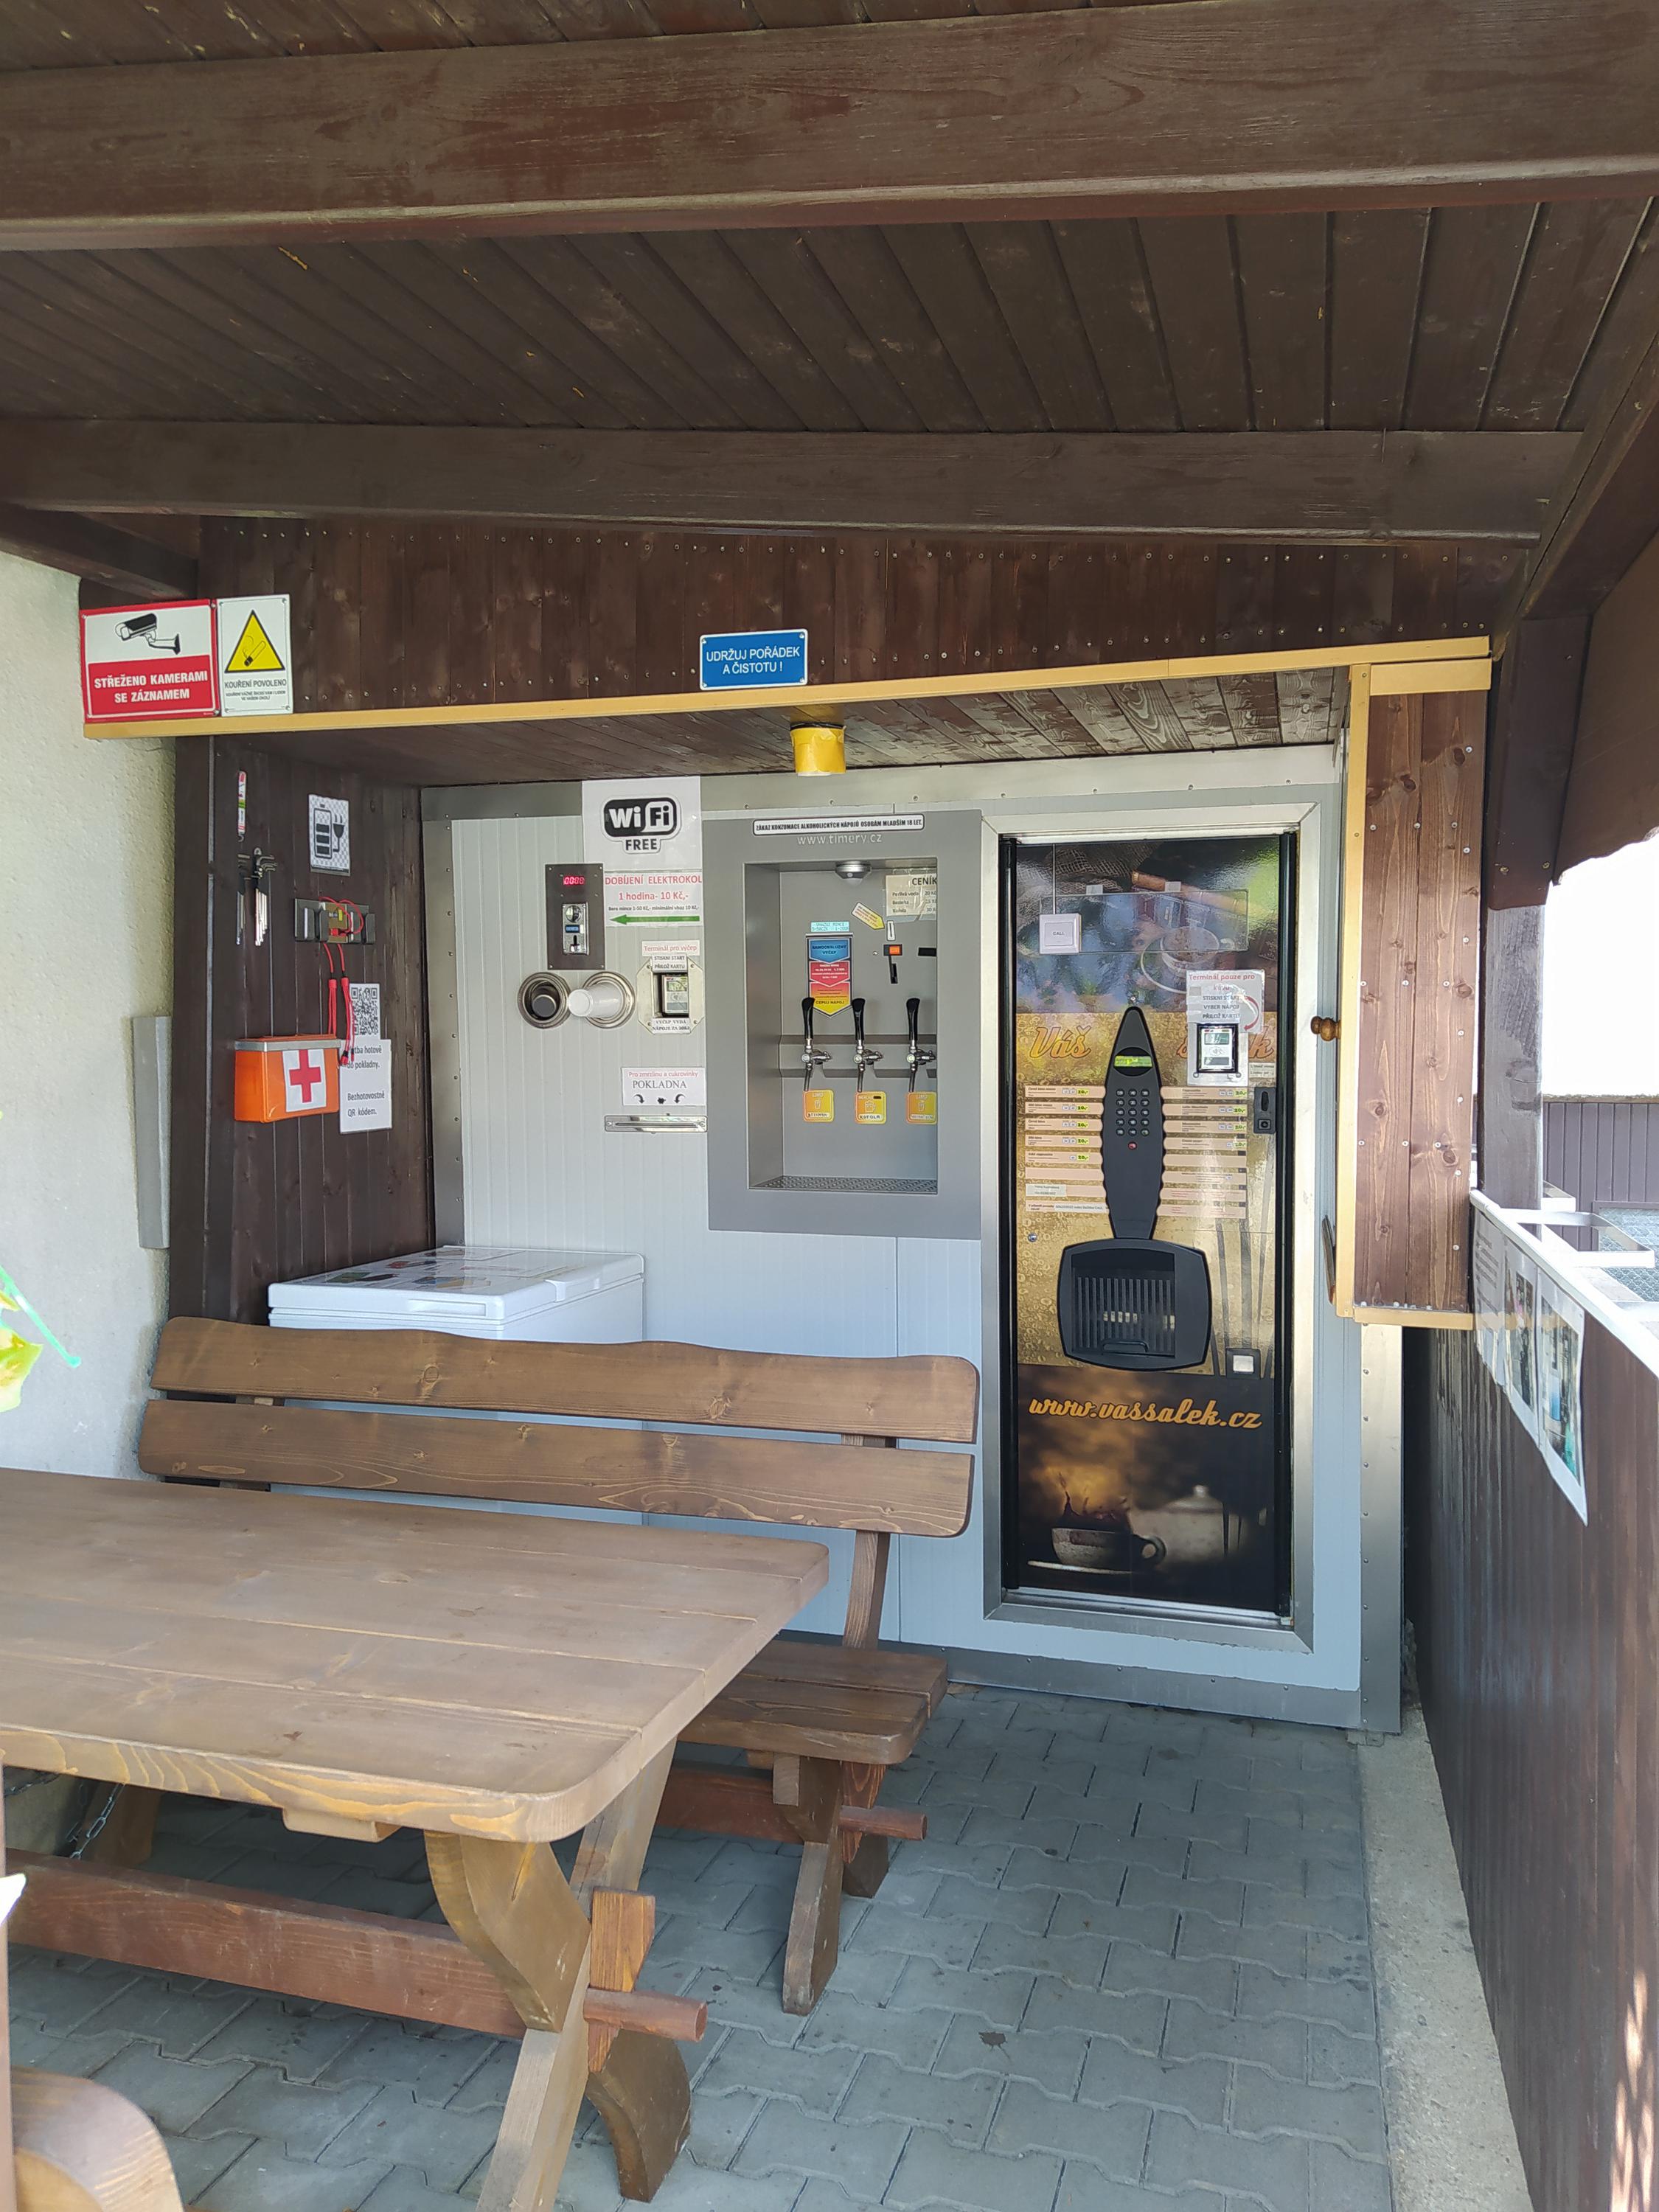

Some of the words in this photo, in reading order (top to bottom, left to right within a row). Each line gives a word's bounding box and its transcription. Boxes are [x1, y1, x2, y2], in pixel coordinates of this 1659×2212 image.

[706, 648, 746, 661] UDRŽUJ
[750, 646, 800, 659] POŘÁDEK
[723, 664, 730, 674] A
[732, 662, 776, 674] ČISTOTU
[779, 661, 783, 672] !
[94, 674, 146, 689] STŘEŽENO
[150, 671, 208, 686] KAMERAMI
[224, 680, 251, 689] KOUŘENÍ
[254, 679, 287, 687] POVOLENO
[114, 692, 128, 703] SE
[131, 689, 189, 702] ZÁZNAMEM
[609, 805, 669, 829] WiFi
[626, 838, 657, 850] FREE
[798, 833, 882, 844] www.timery.cz
[605, 874, 643, 885] DOBÍJENÍ
[649, 875, 702, 884] ELEKTROKOL
[912, 875, 937, 885] CENÍK
[619, 892, 624, 900] 1
[673, 891, 689, 900] Kč,-
[1029, 1025, 1091, 1059] Váš
[364, 1046, 382, 1054] hotově
[355, 1060, 380, 1069] pokladny.
[633, 1080, 686, 1088] POKLADNA
[348, 1091, 385, 1101] Bezhotovostně
[348, 1109, 355, 1117] QR
[358, 1107, 377, 1116] kódem.
[1029, 1398, 1263, 1429] www.vassalek.cz
